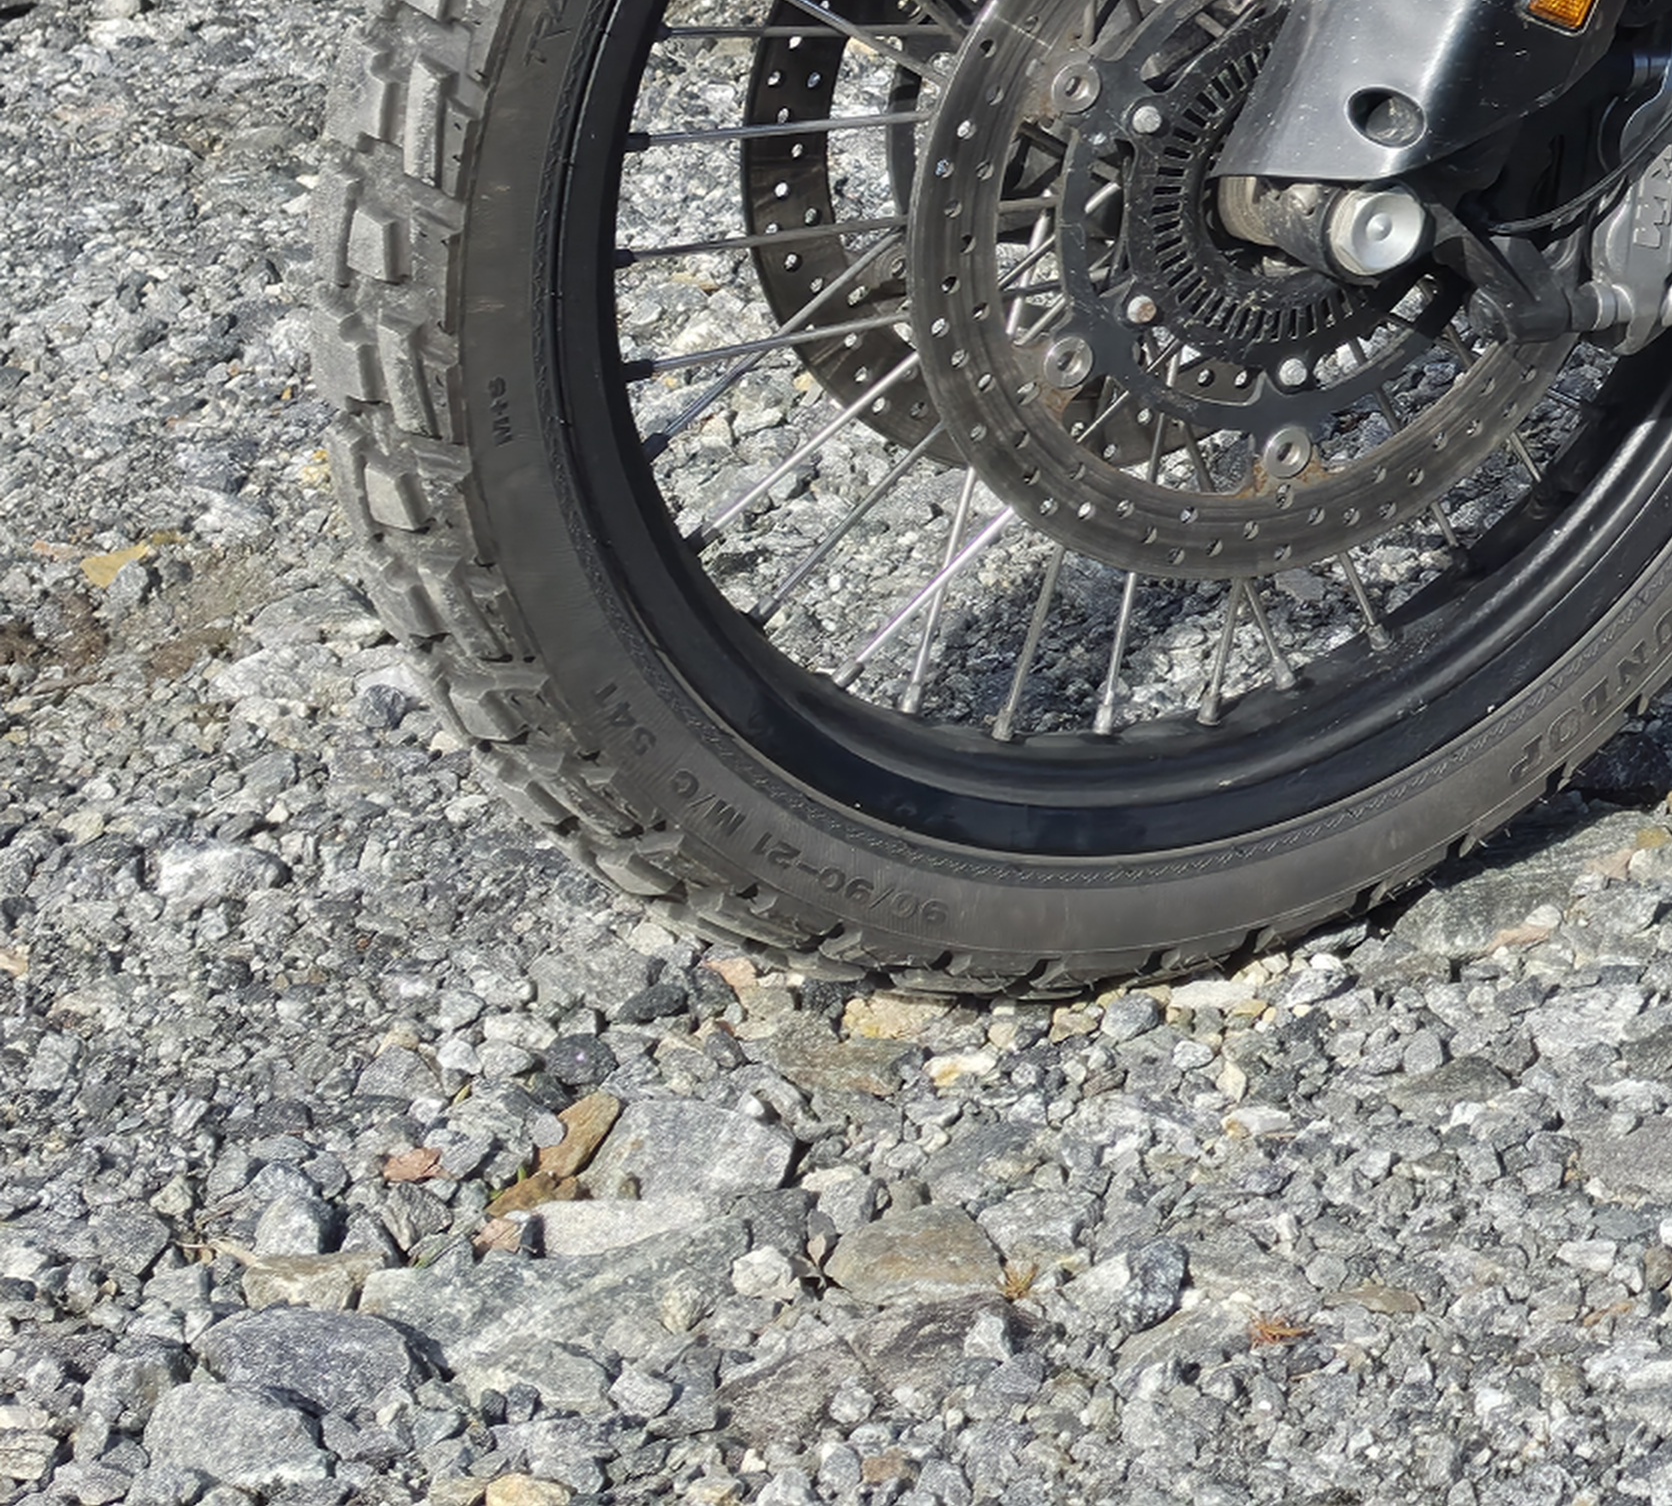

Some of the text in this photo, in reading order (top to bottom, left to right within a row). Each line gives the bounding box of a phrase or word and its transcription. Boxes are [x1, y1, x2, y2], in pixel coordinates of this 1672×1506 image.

[594, 681, 951, 926] 90/90-21 M/C 54T
